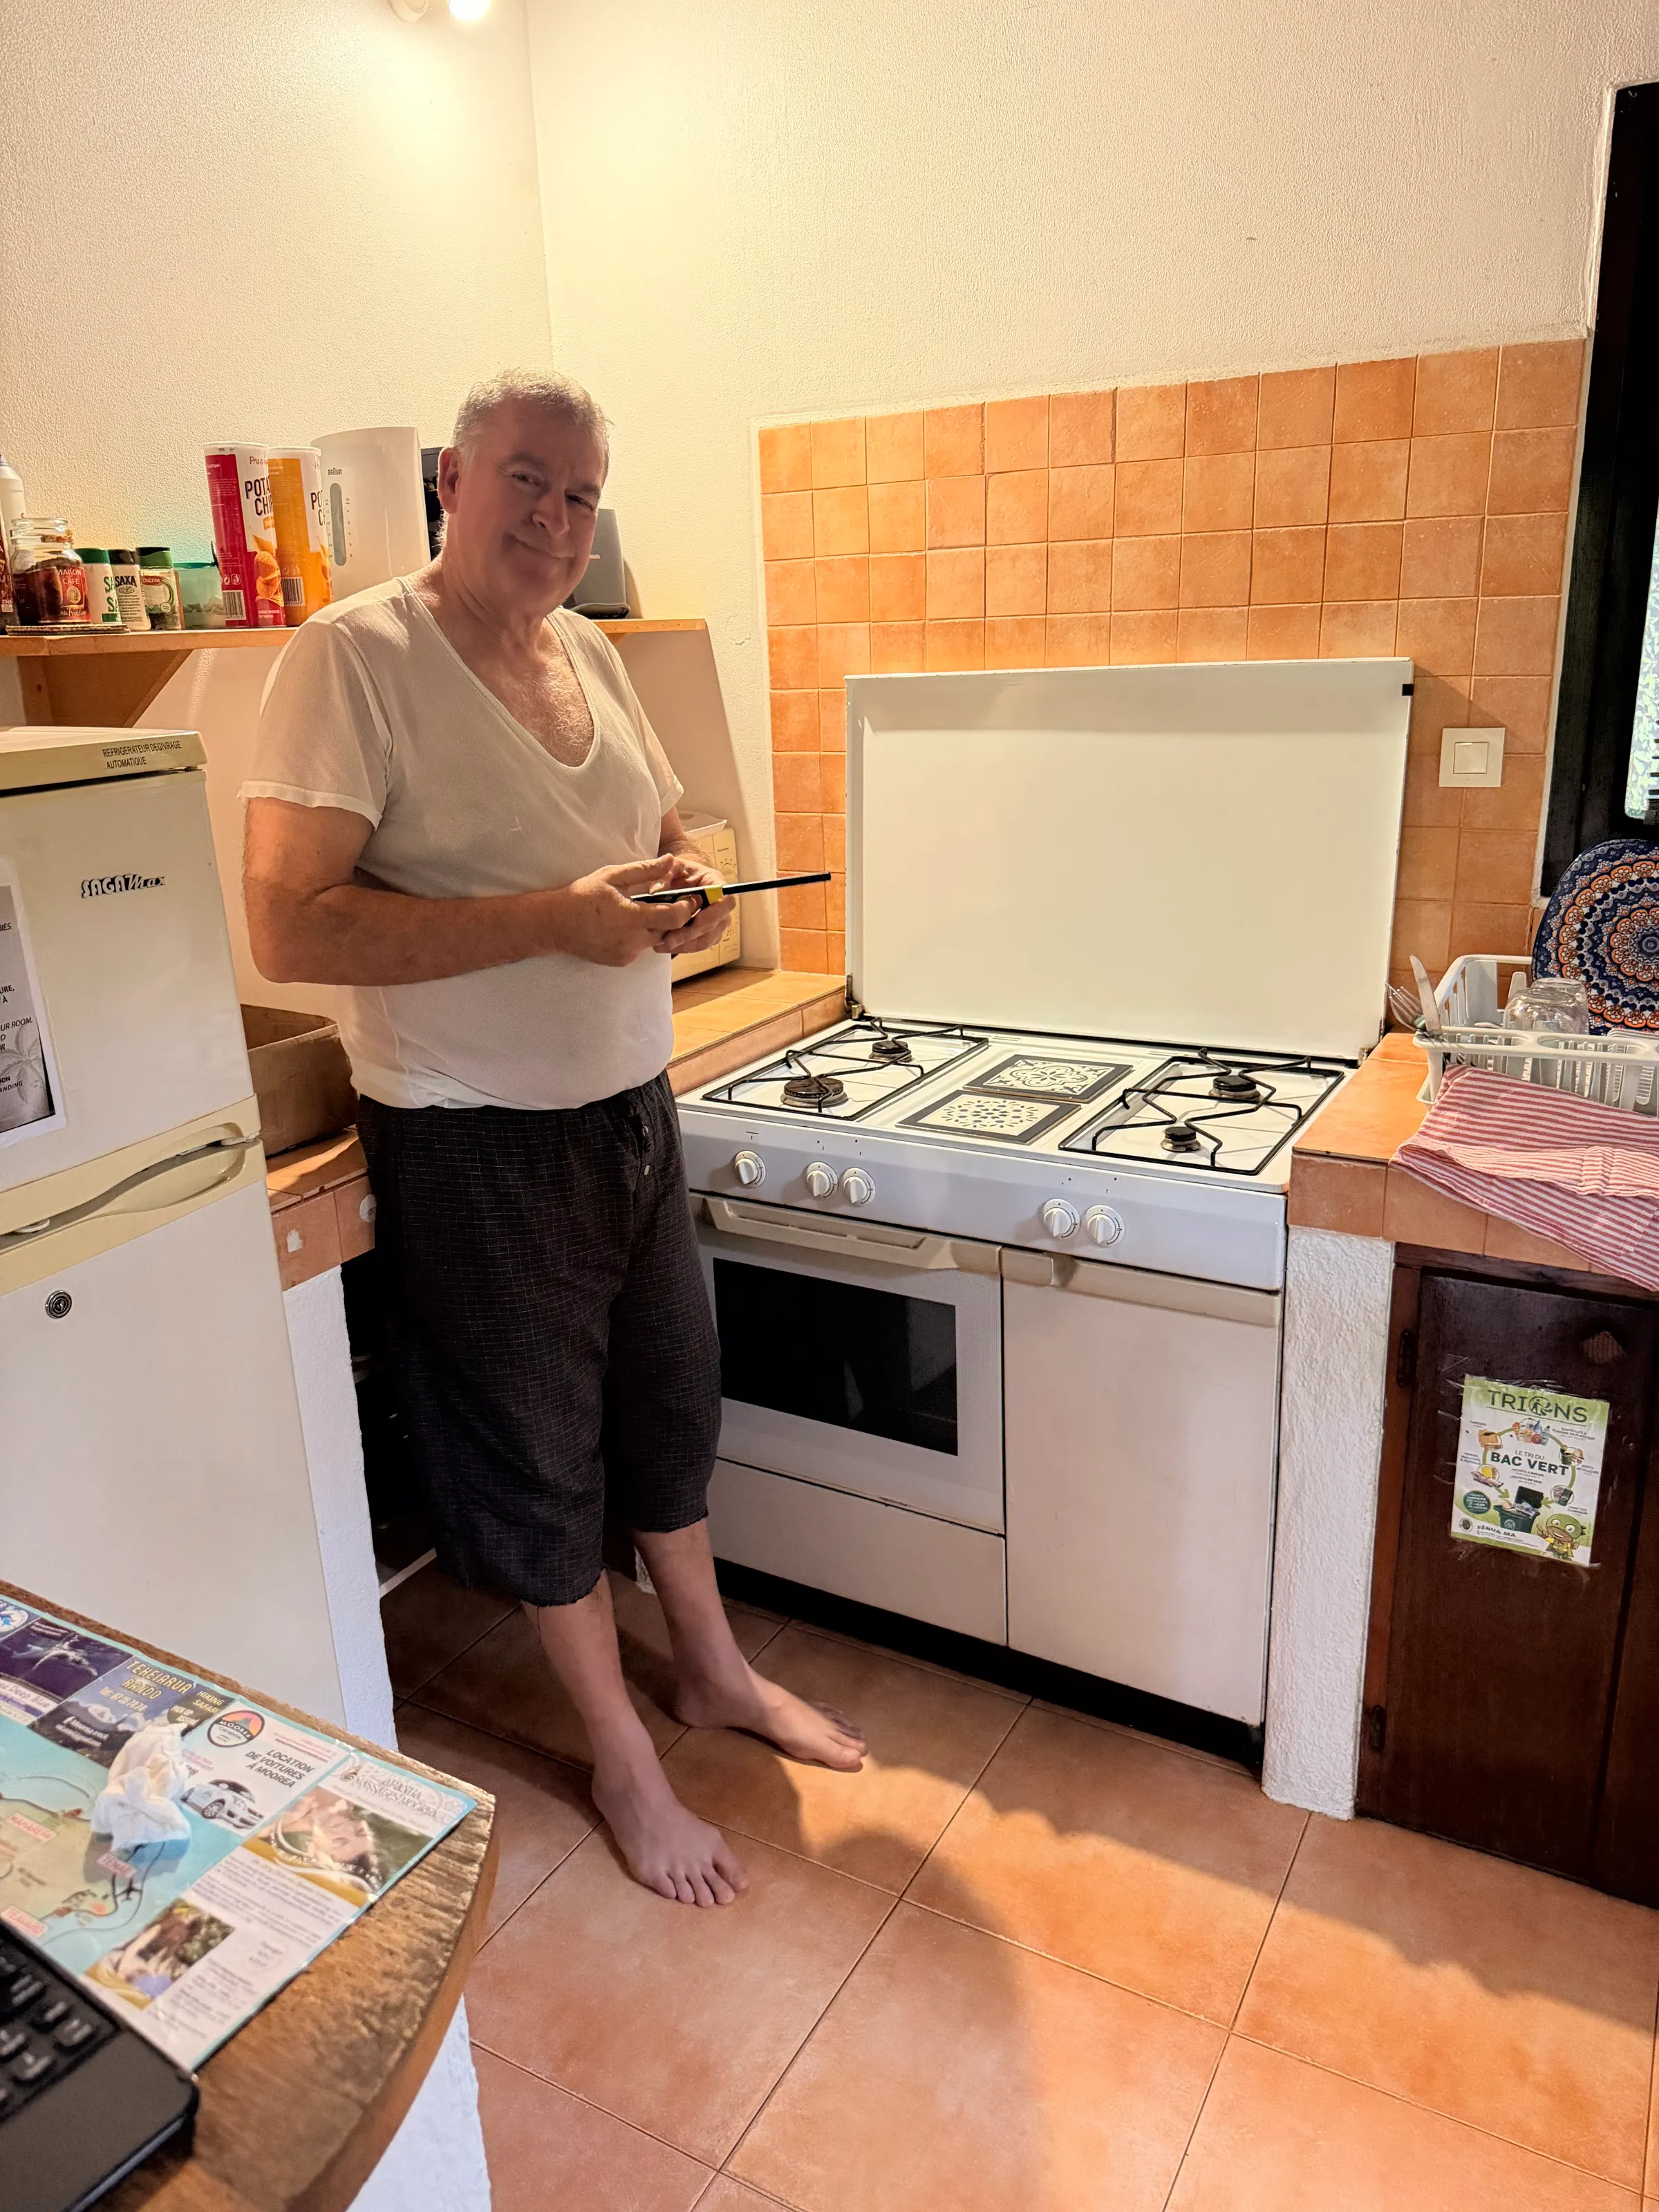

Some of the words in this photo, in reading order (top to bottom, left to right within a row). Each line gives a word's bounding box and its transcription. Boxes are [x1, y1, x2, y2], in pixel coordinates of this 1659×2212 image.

[114, 575, 137, 588] SAXA
[102, 744, 151, 758] REFRIGERATEUR
[150, 740, 182, 752] DEGIVRAGE
[106, 756, 147, 769] AUTOMATIQUE
[1490, 1452, 1522, 1466] BAC
[1527, 1458, 1569, 1476] VERT
[122, 1678, 162, 1700] RANDO
[192, 1699, 221, 1714] SAFARI
[196, 1691, 225, 1707] HIKING
[245, 1751, 261, 1761] DE
[260, 1757, 306, 1781] VOITURES
[266, 1750, 315, 1774] LOCATION
[254, 1767, 298, 1788] MOOREA
